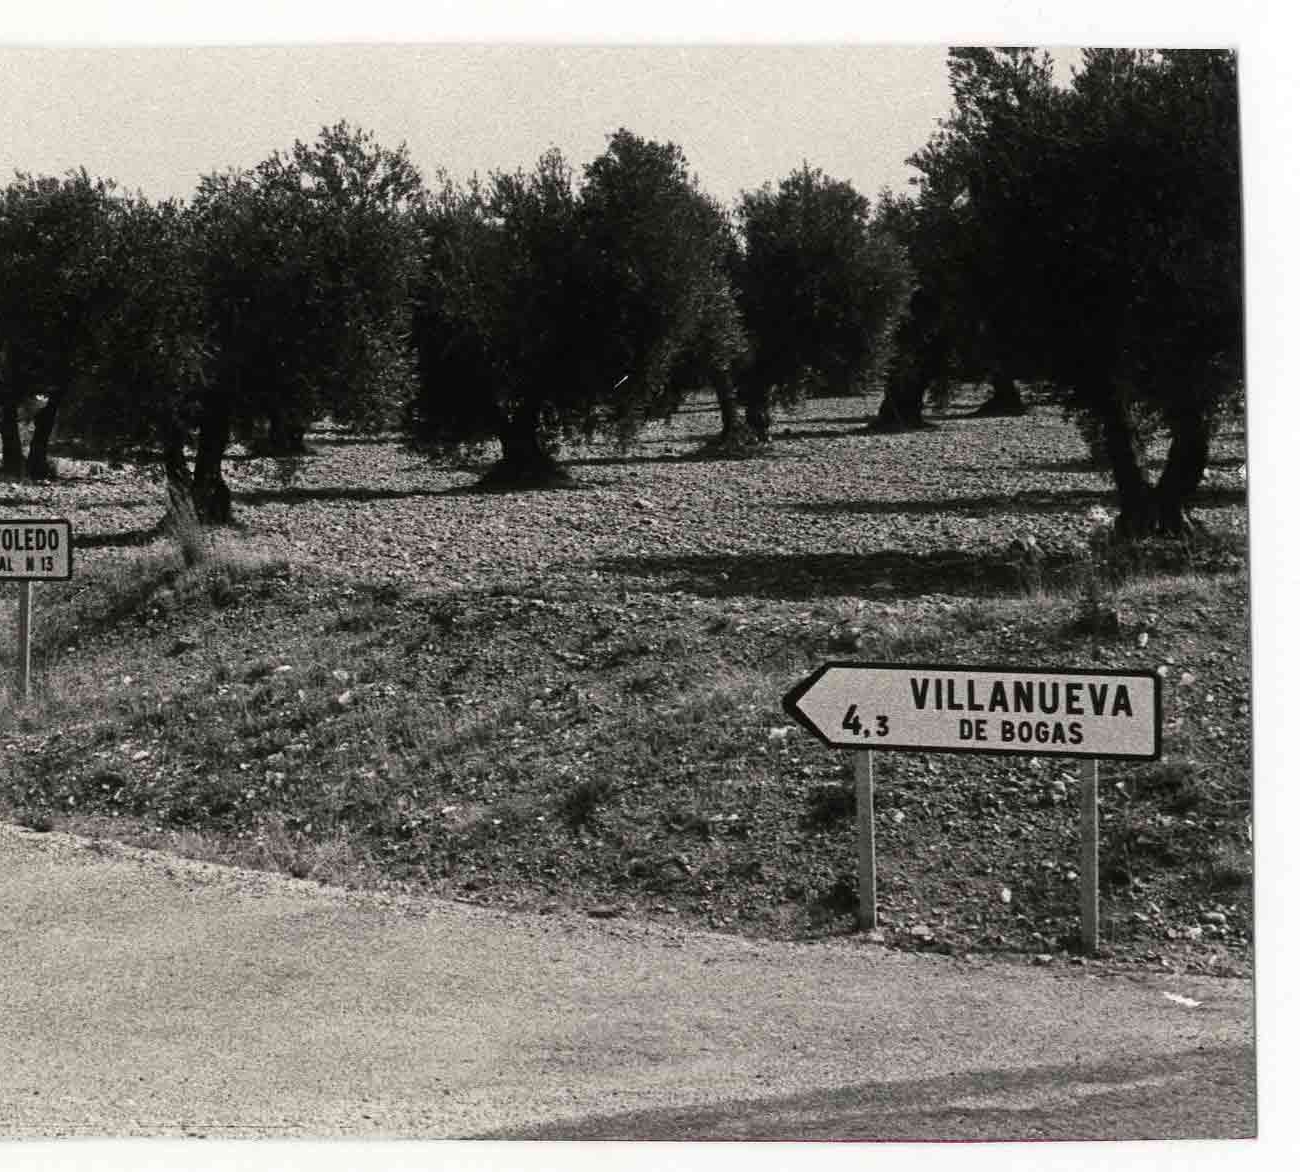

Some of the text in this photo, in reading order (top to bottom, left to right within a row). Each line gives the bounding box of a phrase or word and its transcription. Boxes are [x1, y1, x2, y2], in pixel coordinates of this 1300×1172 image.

[41, 556, 54, 572] 13
[910, 678, 1133, 717] VILLANUEVA
[842, 704, 890, 738] 4,3
[959, 719, 1083, 745] DE BOGAS
